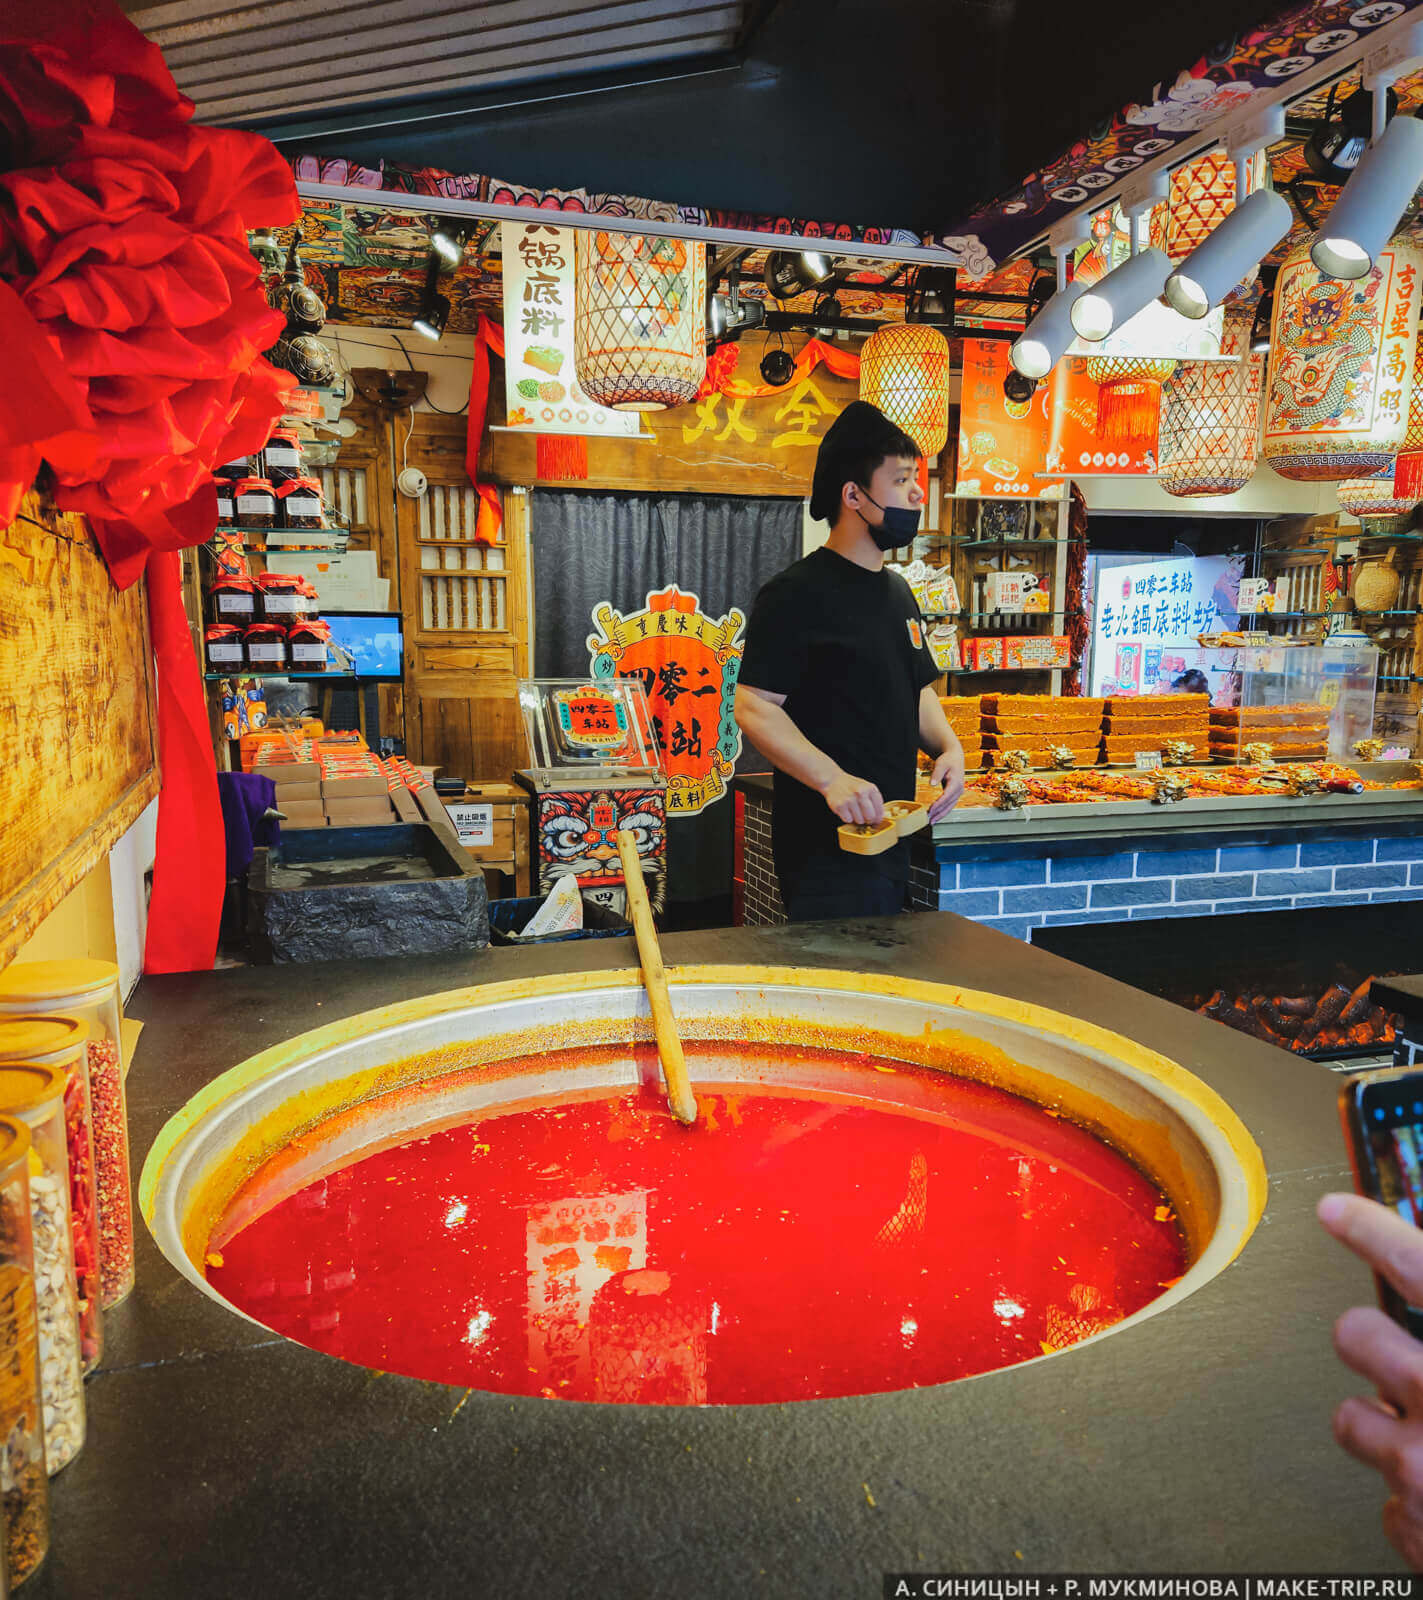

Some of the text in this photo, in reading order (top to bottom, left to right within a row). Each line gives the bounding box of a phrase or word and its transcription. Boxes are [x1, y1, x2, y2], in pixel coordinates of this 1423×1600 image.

[1377, 263, 1416, 425] 吉星高照
[1135, 571, 1193, 598] 四零二车站
[619, 661, 718, 706] 四零二
